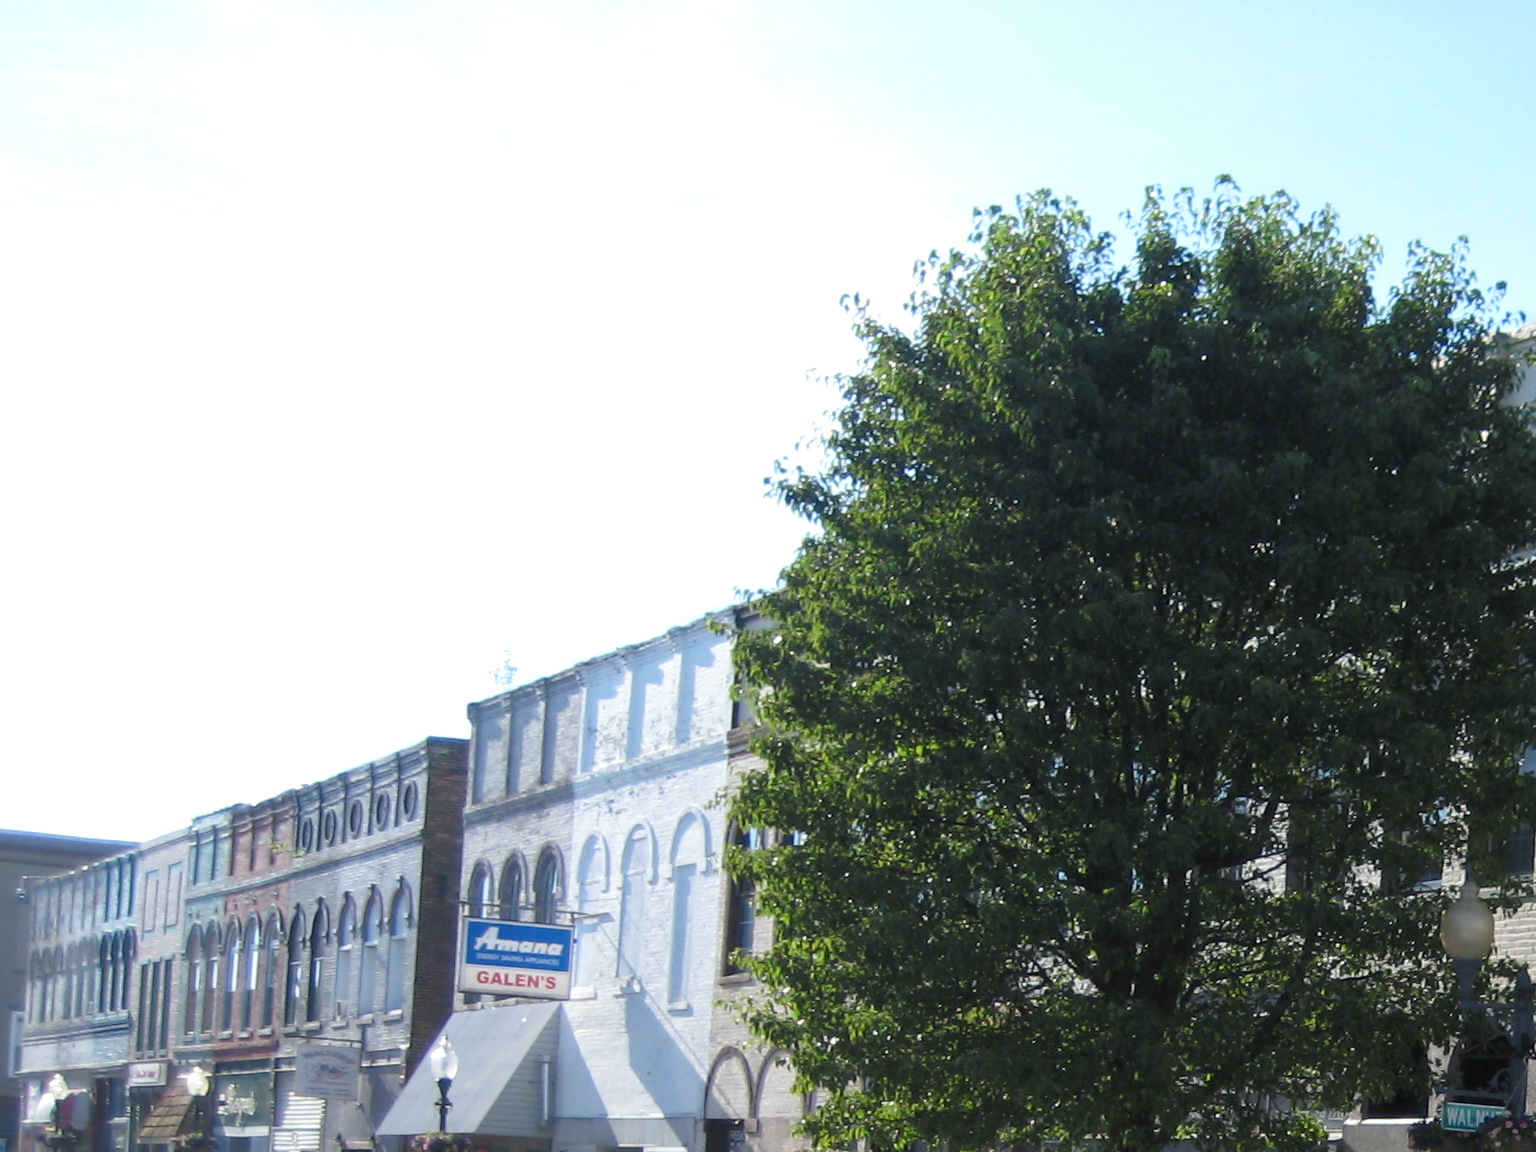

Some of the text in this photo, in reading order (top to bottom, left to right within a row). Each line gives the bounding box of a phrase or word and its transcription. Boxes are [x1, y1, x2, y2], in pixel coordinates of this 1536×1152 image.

[473, 926, 564, 956] Amana
[476, 970, 557, 990] GALEN'S
[1446, 1107, 1504, 1127] WALN
